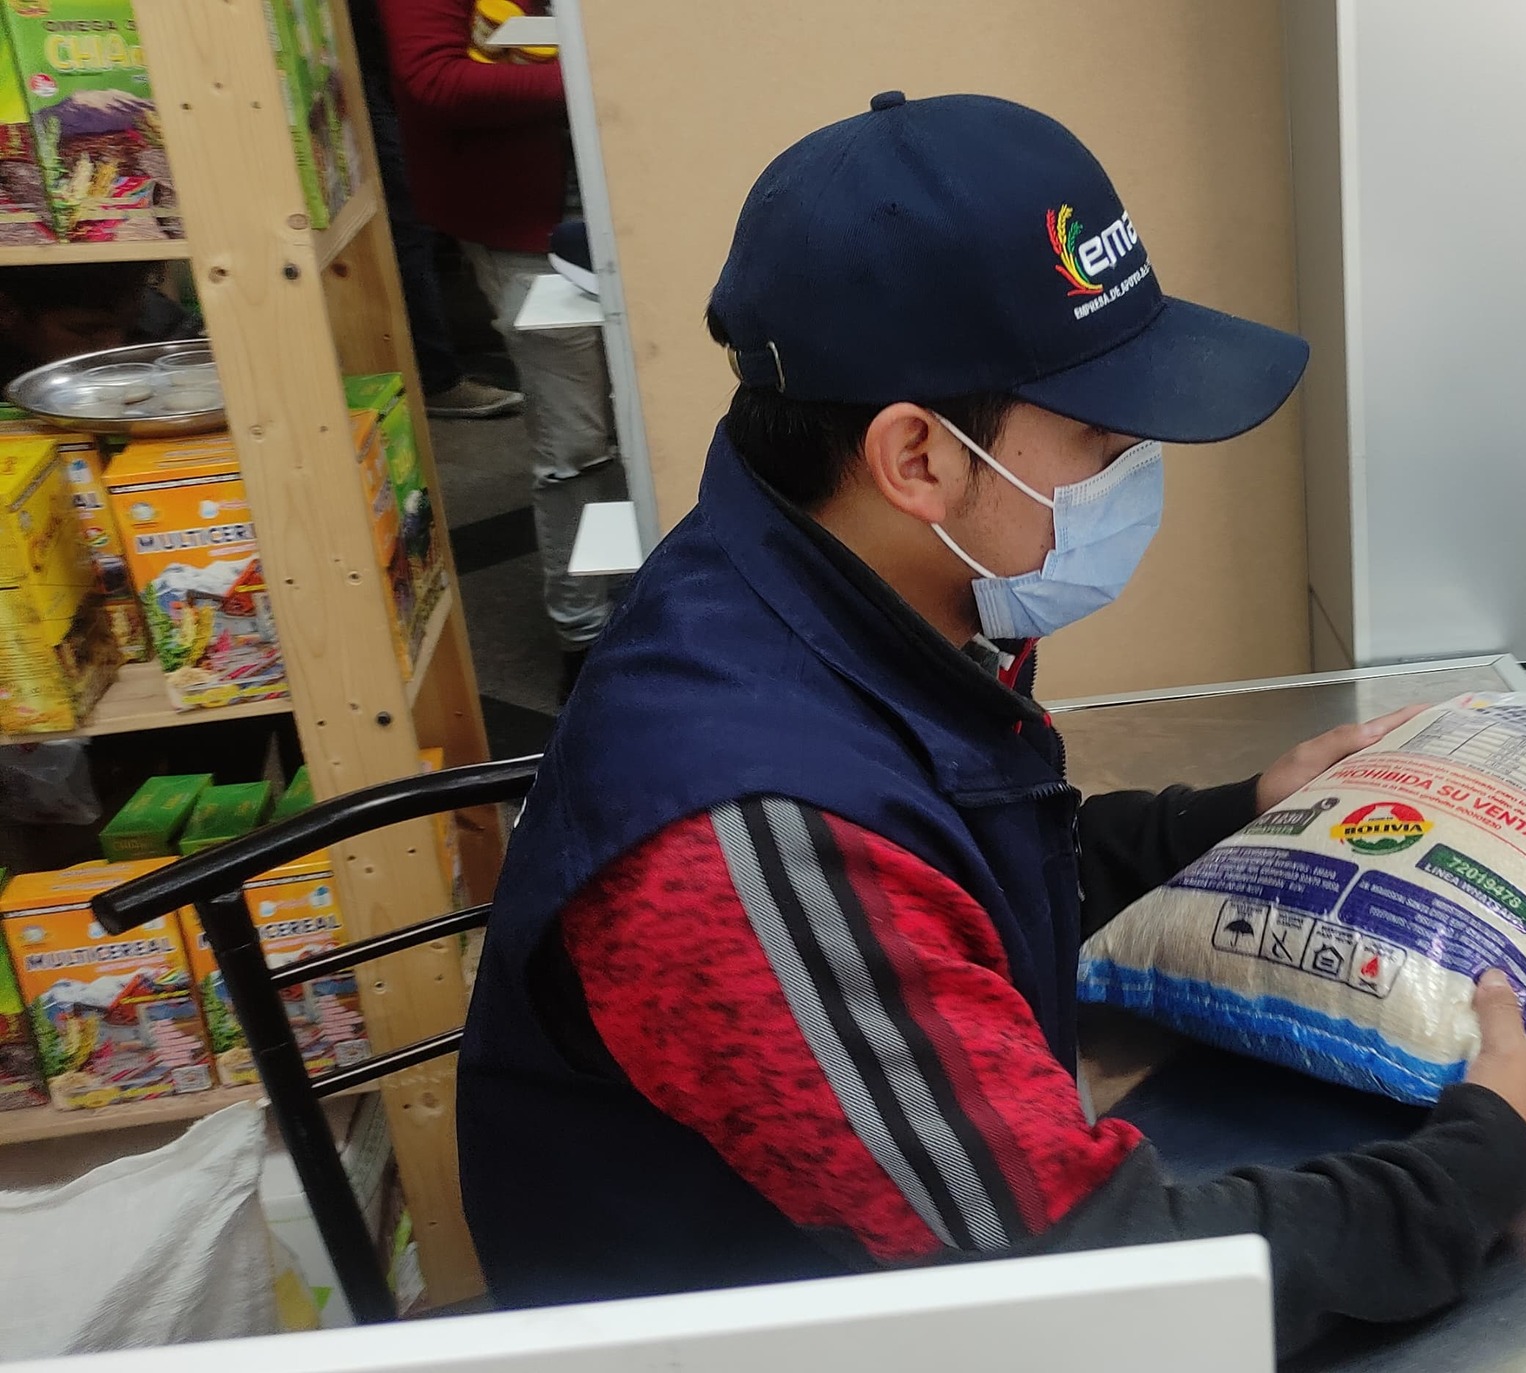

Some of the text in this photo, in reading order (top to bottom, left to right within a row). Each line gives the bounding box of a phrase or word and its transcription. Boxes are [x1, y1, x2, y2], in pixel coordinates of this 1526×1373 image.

[1327, 769, 1433, 790] PROHIBIDA
[1437, 785, 1470, 801] SU
[1344, 823, 1423, 836] BOLIVIA
[1424, 862, 1460, 886] LINEA
[1447, 856, 1522, 909] 72019478
[26, 937, 176, 971] MULTICEREAL
